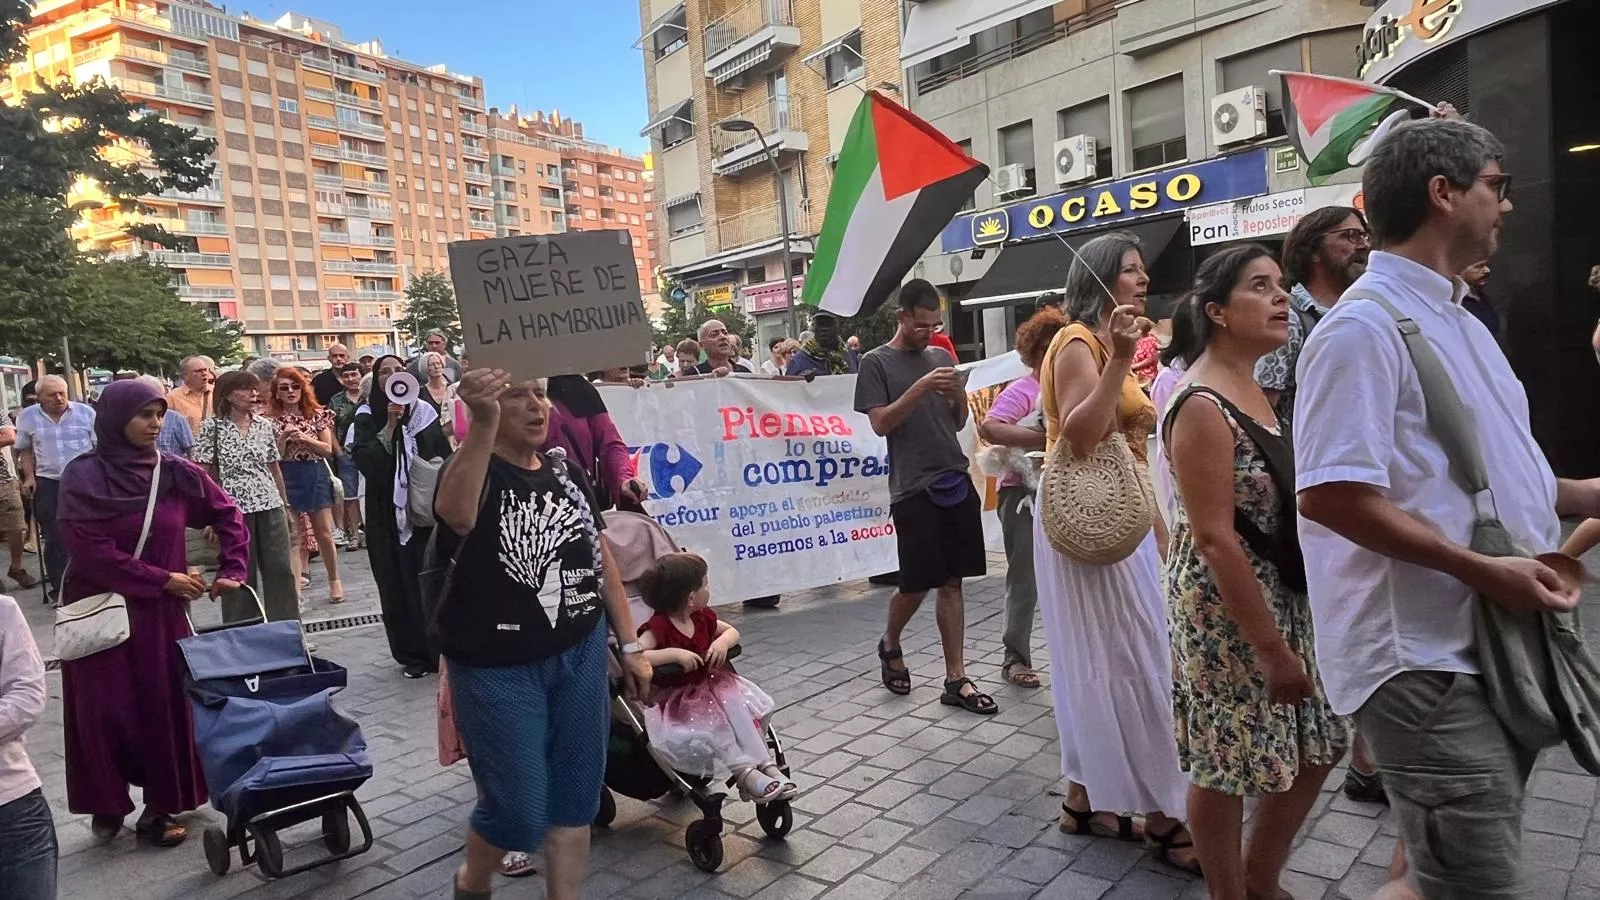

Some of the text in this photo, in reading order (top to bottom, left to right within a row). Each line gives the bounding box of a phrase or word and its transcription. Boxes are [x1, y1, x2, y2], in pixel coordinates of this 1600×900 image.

[1028, 173, 1201, 229] OCASO
[1191, 207, 1230, 221] Aperitivos
[1242, 196, 1304, 214] Frutos Secos
[1192, 224, 1229, 242] Pan
[476, 241, 569, 274] GAZA
[482, 263, 627, 305] MUERE DE
[477, 301, 641, 345] LA HAMBRUNA
[718, 405, 852, 442] Piensa
[785, 439, 852, 459] lo que
[652, 505, 720, 526] refour
[729, 499, 778, 520] apoya
[782, 497, 795, 511] el
[731, 520, 756, 538] del
[760, 513, 811, 536] pueblo
[734, 538, 814, 561] Pasemos
[818, 535, 828, 547] a
[830, 530, 848, 545] la
